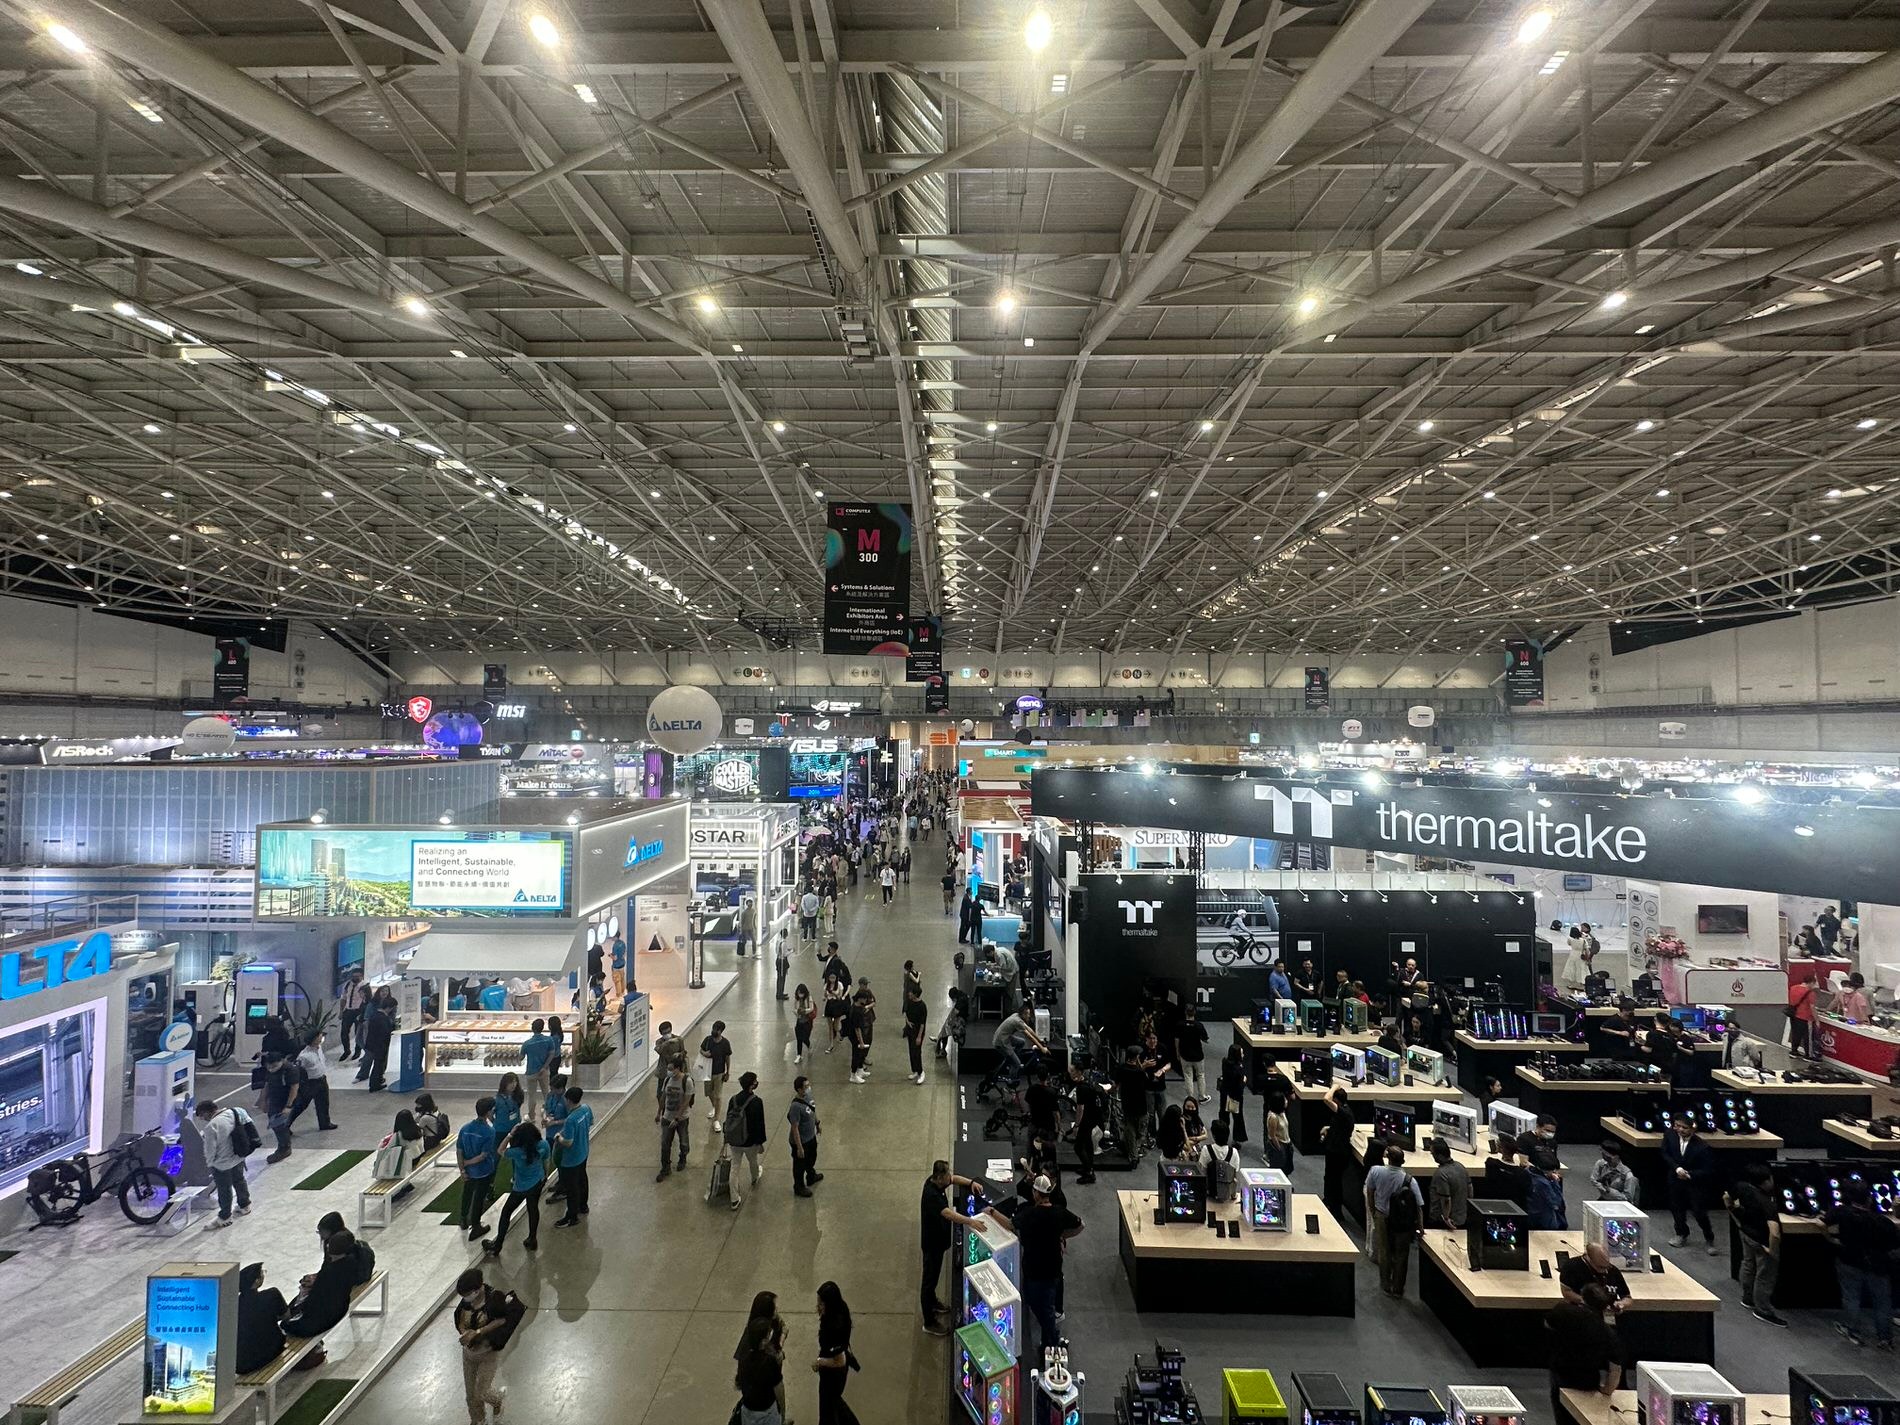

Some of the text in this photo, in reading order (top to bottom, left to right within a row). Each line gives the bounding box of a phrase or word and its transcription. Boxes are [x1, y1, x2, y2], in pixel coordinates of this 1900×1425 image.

[857, 529, 880, 551] M
[859, 553, 878, 562] 300
[840, 583, 863, 592] Systems
[919, 627, 929, 637] M
[1520, 650, 1529, 661] N
[1019, 700, 1041, 708] BenQ
[496, 704, 526, 718] msi
[663, 720, 702, 730] DELTA
[52, 745, 114, 757] ASRock
[789, 739, 838, 753] ASUS
[480, 747, 501, 756] TYAN
[716, 761, 750, 776] COOLER
[516, 781, 540, 789] Make
[690, 829, 745, 843] STAR
[1375, 800, 1647, 863] thermaltake
[418, 847, 455, 857] Realizing
[640, 840, 664, 861] DELTA
[418, 858, 516, 866] Intelligent, Sustainable,
[436, 868, 484, 877] Connecting
[485, 868, 510, 876] World
[0, 931, 111, 1000] LTA
[157, 1286, 190, 1294] Intelligent
[156, 1304, 194, 1312] Connecting
